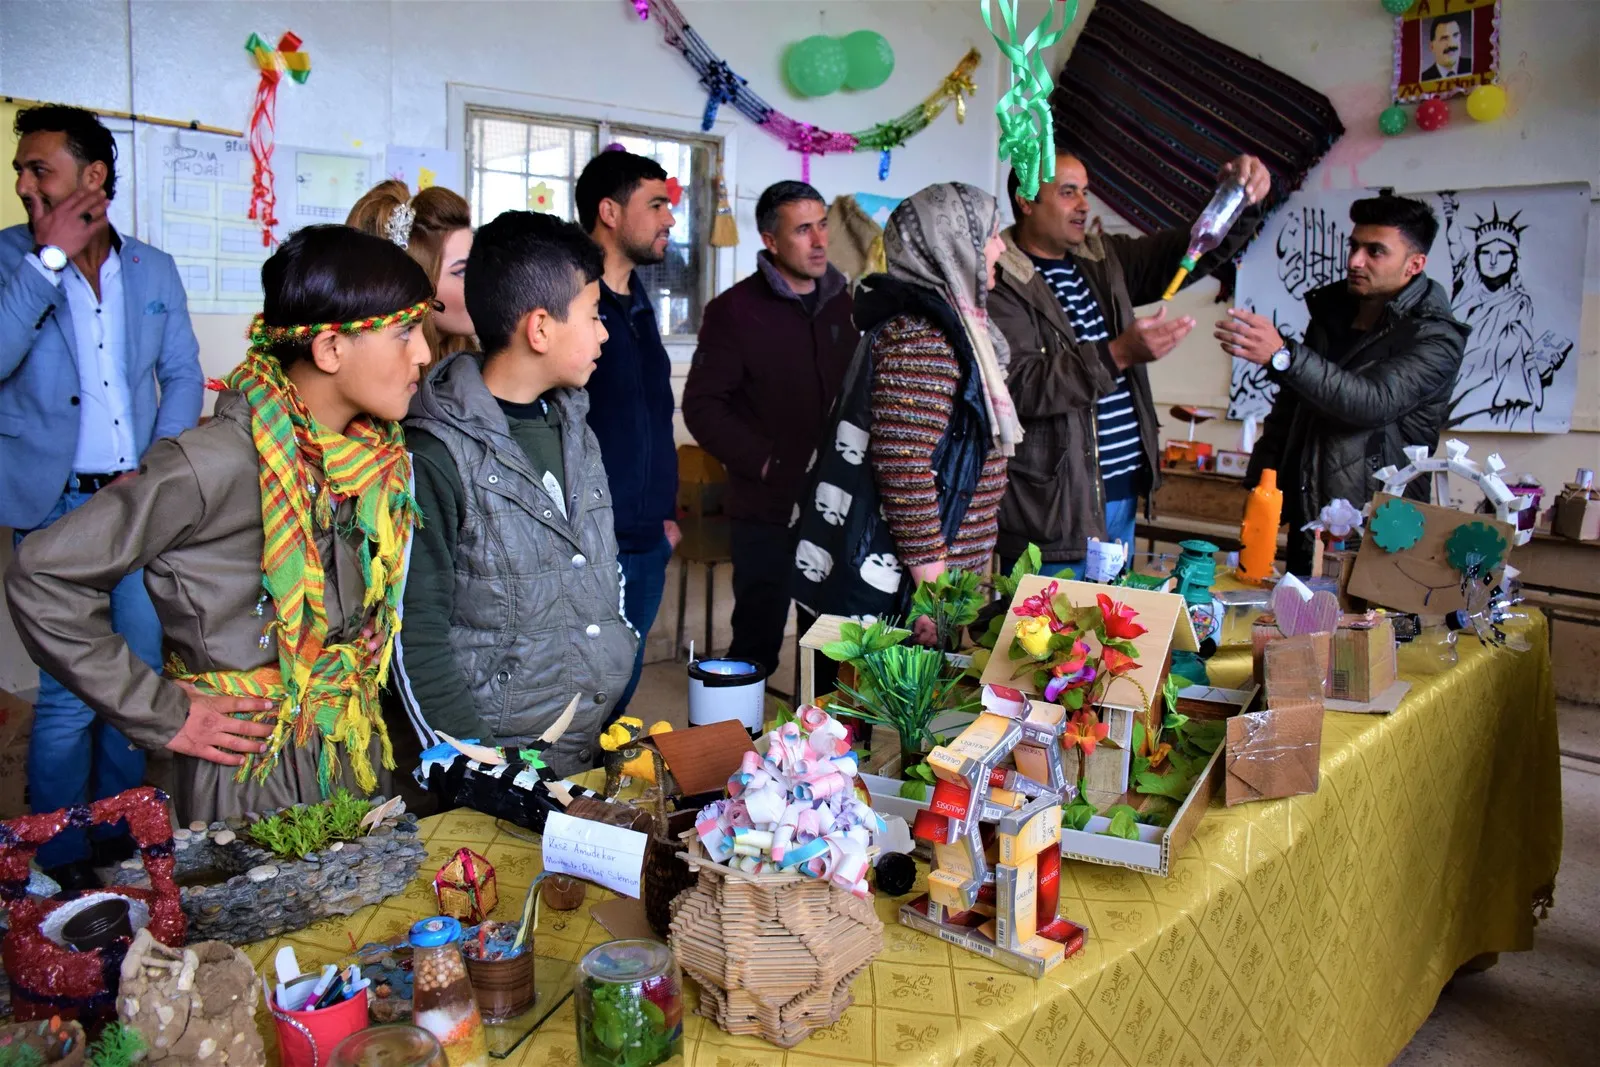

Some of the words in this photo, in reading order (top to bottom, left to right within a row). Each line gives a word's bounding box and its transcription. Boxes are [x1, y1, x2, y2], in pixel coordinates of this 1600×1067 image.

[933, 751, 962, 766] GAULOISES
[936, 800, 966, 816] GAULOISES
[1040, 869, 1059, 885] GAULOISES
